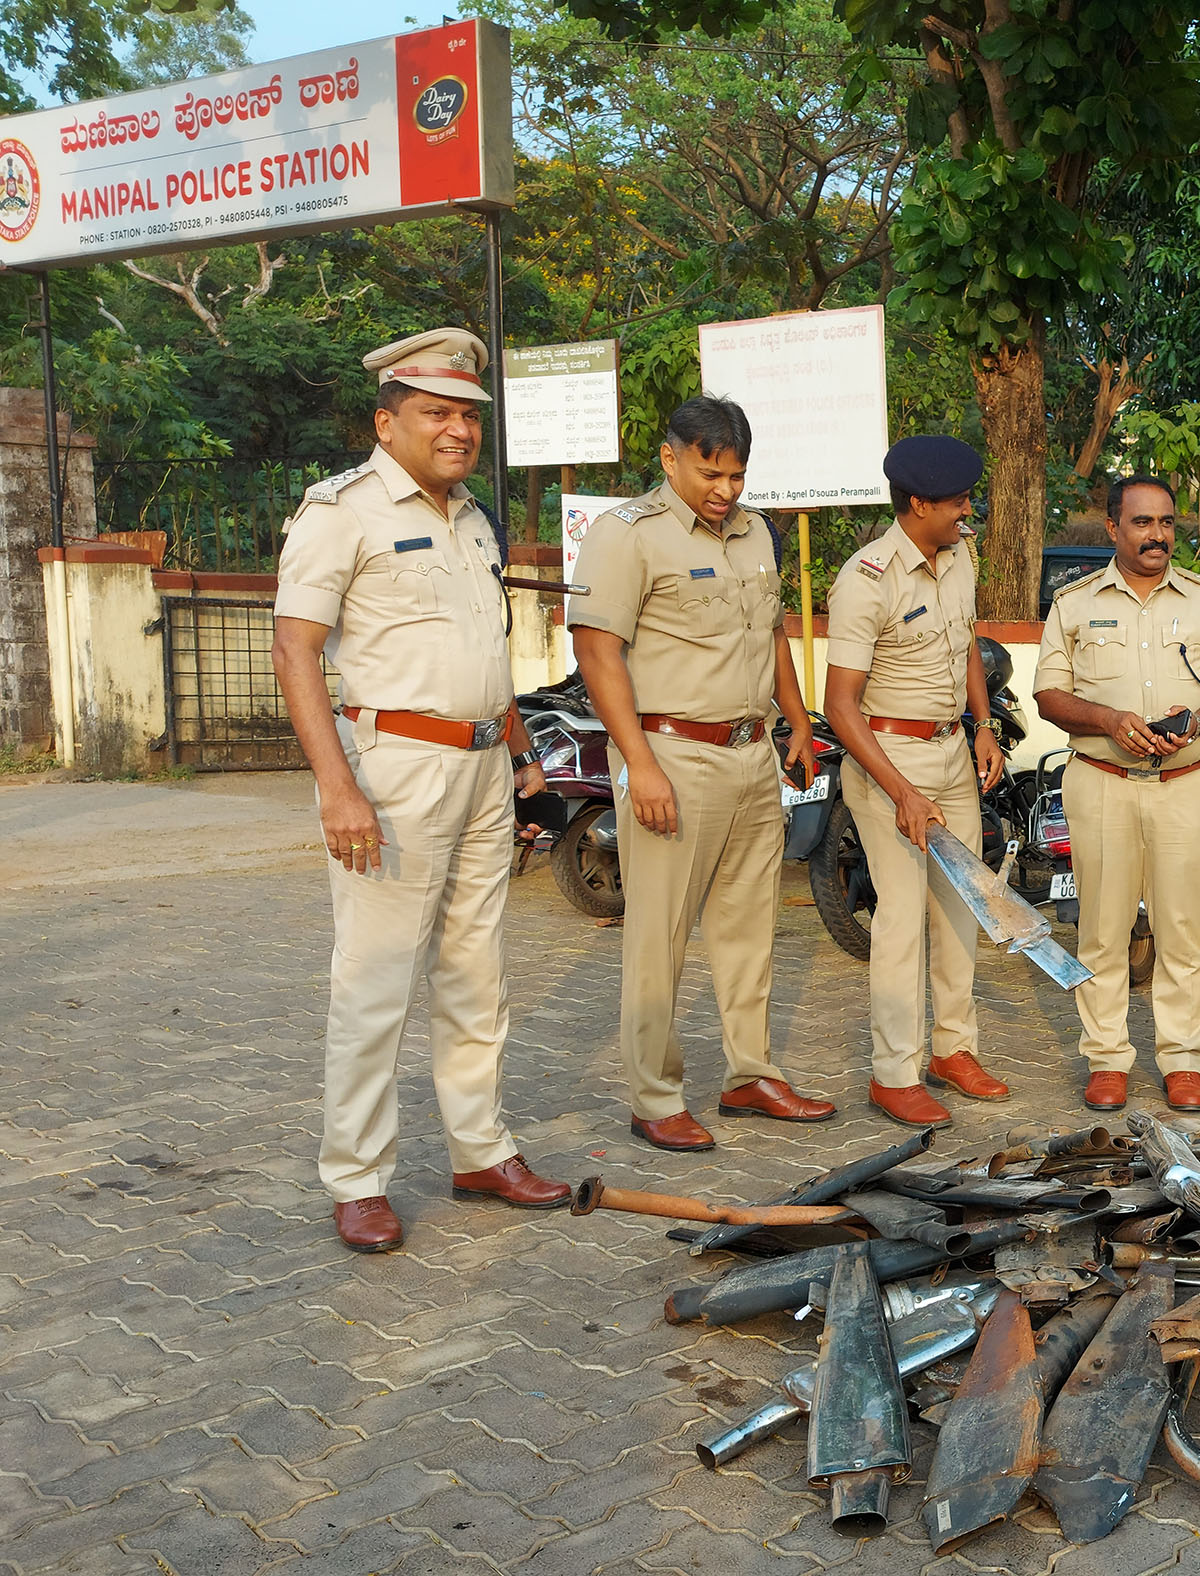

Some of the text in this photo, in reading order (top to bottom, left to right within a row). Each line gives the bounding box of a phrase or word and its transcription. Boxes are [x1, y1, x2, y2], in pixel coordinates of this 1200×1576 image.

[60, 56, 359, 154] ಮಣಿಪಾಲ ಪೊಲೀಸ್ ಠಾಣೆ
[422, 87, 457, 108] Dairy
[427, 104, 453, 126] Day
[426, 127, 457, 142] LOTS OF FUN
[61, 139, 370, 224] MANIPAL POLICE STATION
[14, 223, 30, 240] STATE
[28, 192, 39, 226] POLICE
[79, 232, 105, 245] PHONE
[110, 227, 141, 241] STATION
[147, 217, 204, 235] 0820-2570328,
[205, 216, 213, 226] PI
[220, 207, 273, 225] 9480805448,
[274, 205, 288, 216] PSI
[295, 195, 349, 213] 9480805475
[747, 491, 768, 501] Donet
[770, 490, 780, 501] By
[786, 489, 808, 501] Agnel
[809, 488, 839, 498] D'souza
[840, 486, 881, 498] Perampalli
